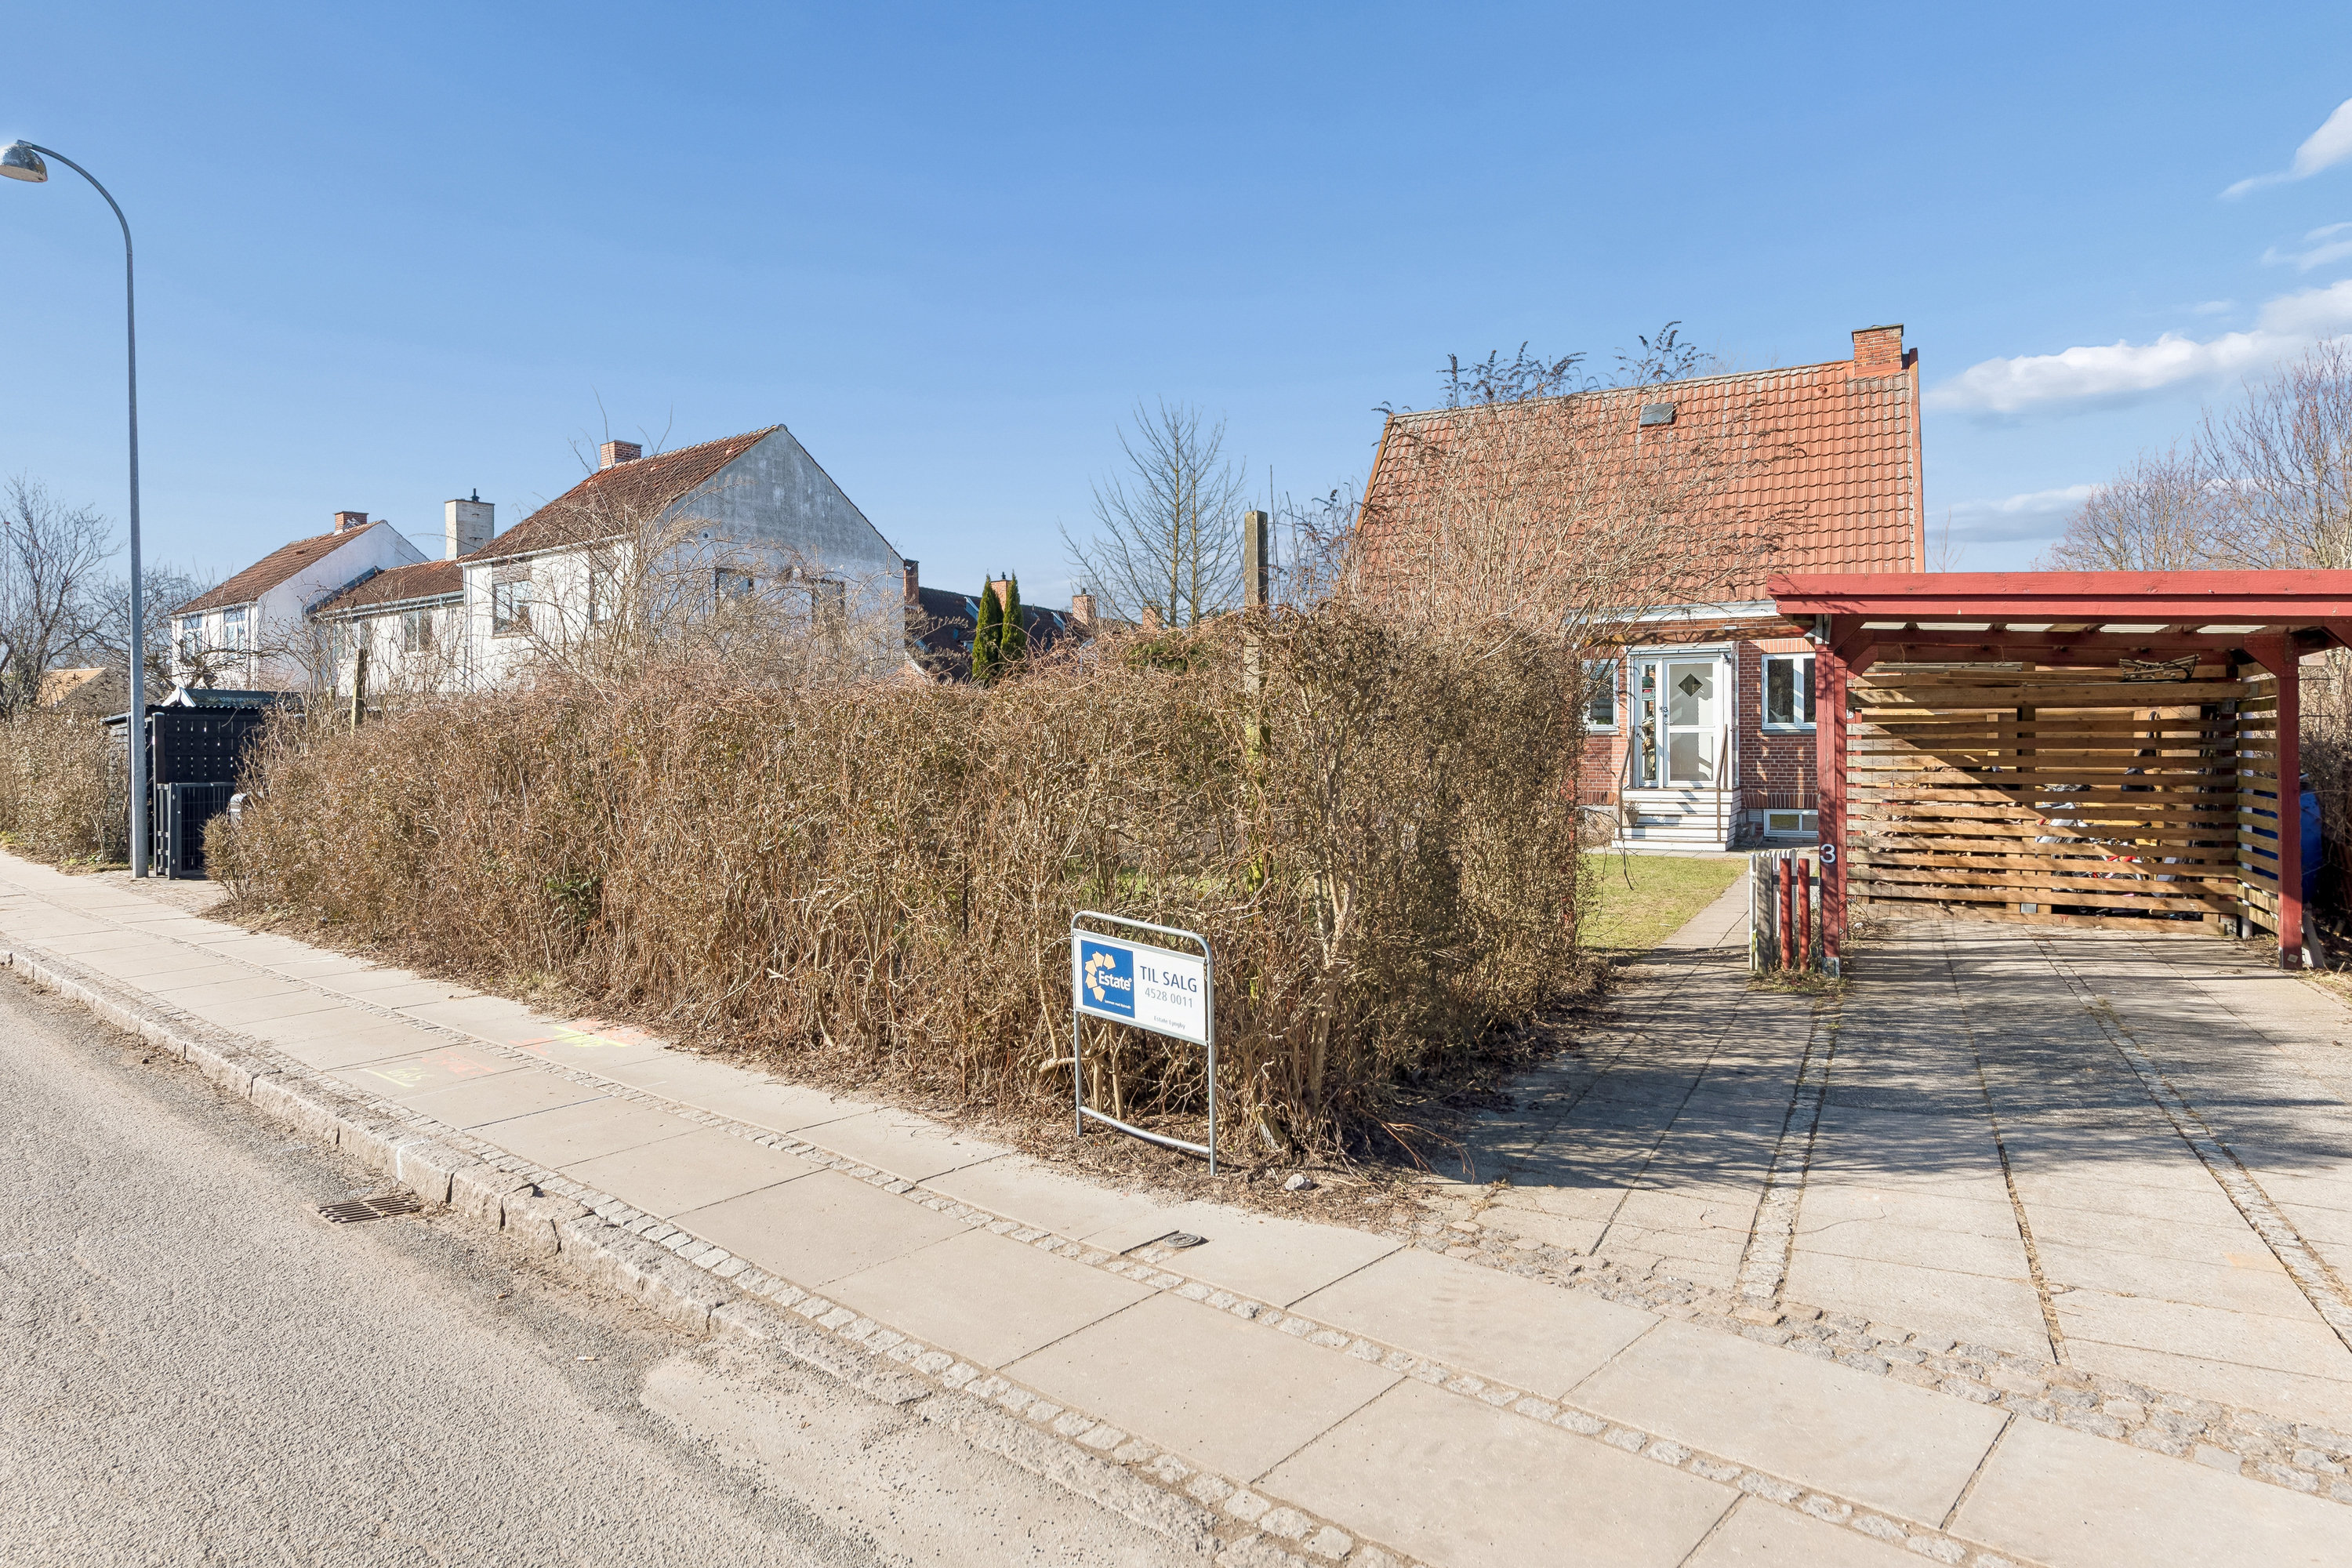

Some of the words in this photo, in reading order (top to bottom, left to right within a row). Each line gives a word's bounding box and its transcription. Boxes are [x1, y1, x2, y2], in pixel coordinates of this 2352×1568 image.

[1820, 844, 1836, 864] 3
[1098, 970, 1131, 992] Estate
[1140, 965, 1159, 984] TIL
[1163, 971, 1197, 993] SALG
[1145, 987, 1167, 1002] 4528
[1170, 993, 1192, 1008] 0011
